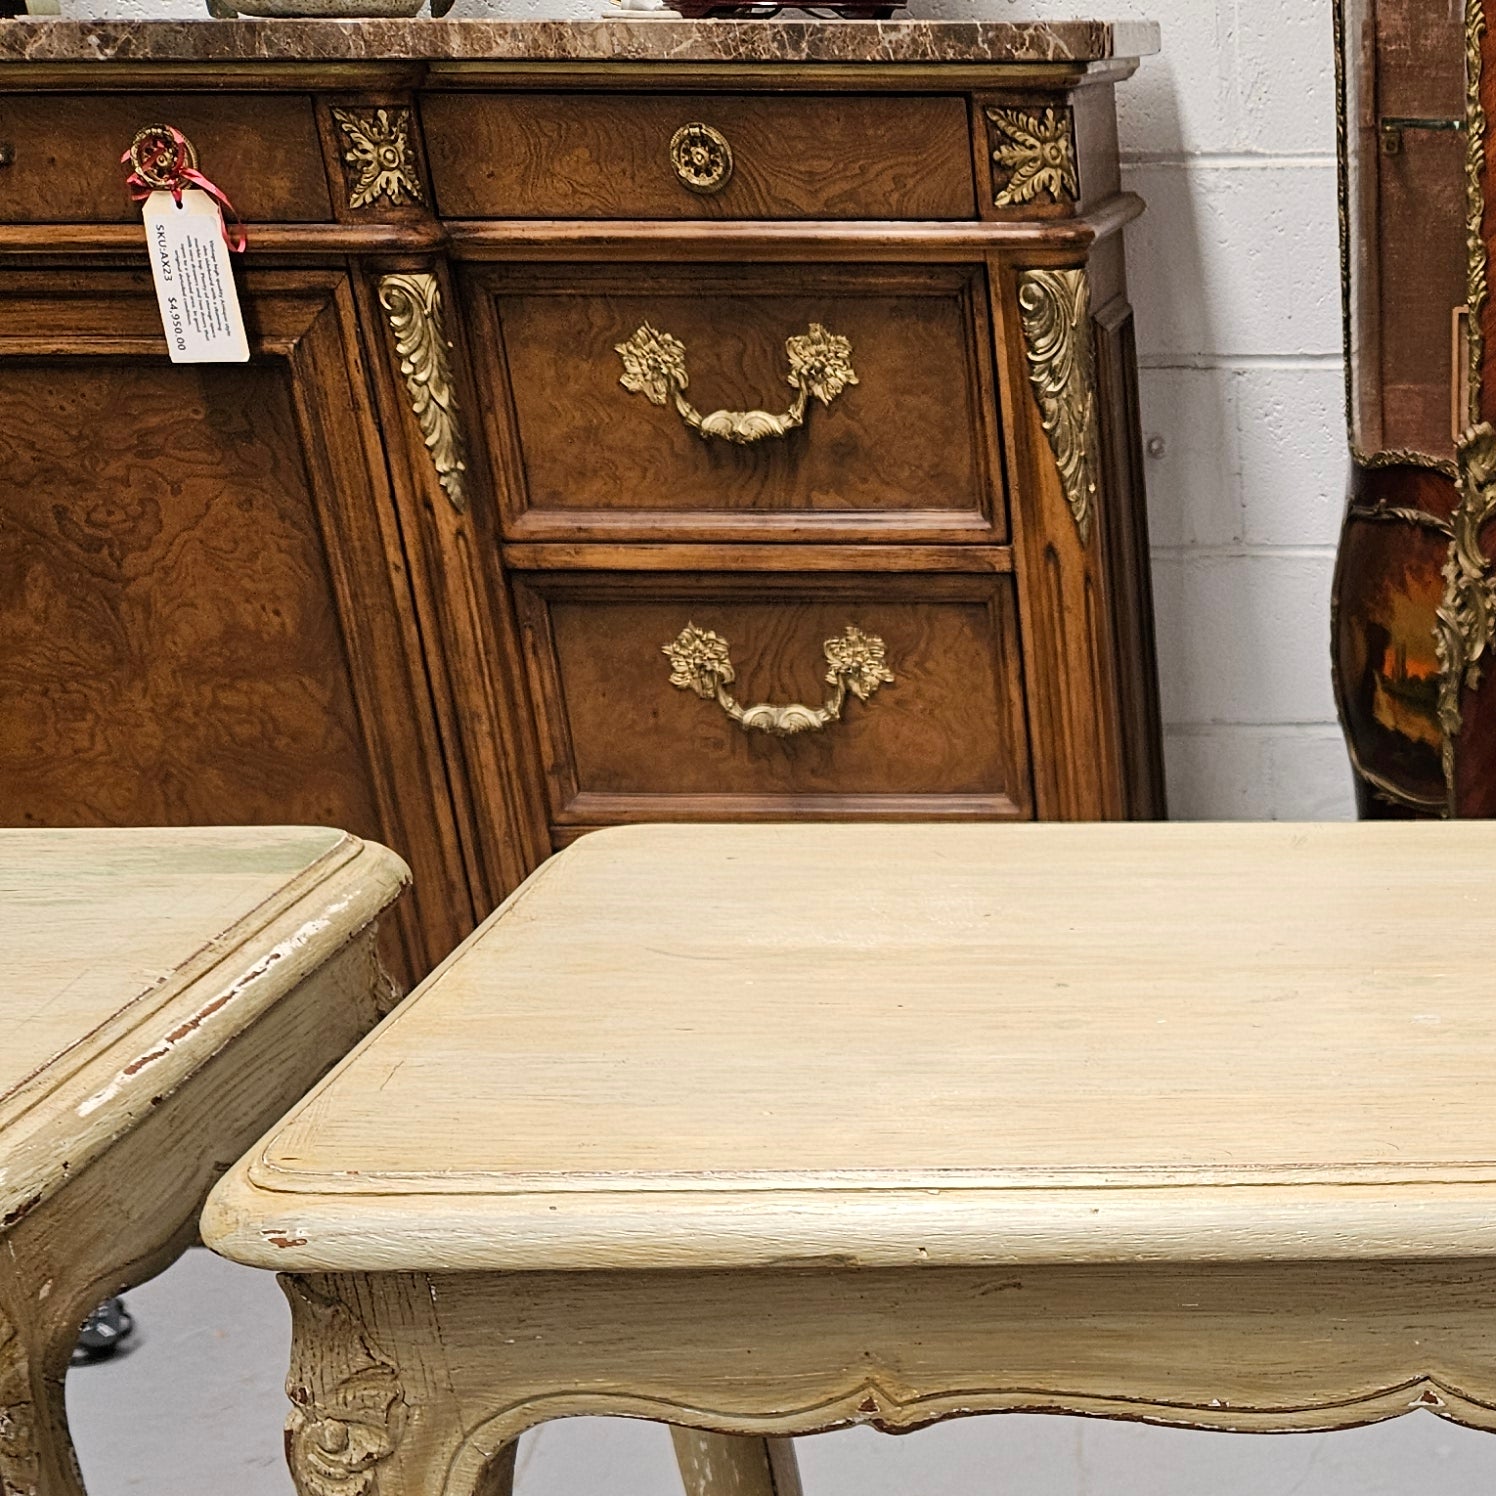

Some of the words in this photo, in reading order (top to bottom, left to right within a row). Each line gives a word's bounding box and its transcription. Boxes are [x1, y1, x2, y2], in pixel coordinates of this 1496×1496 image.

[155, 224, 172, 281] SKU:AX23
[167, 297, 186, 350] $4,950.00
[205, 257, 214, 286] sideboard
[214, 306, 222, 331] stunning
